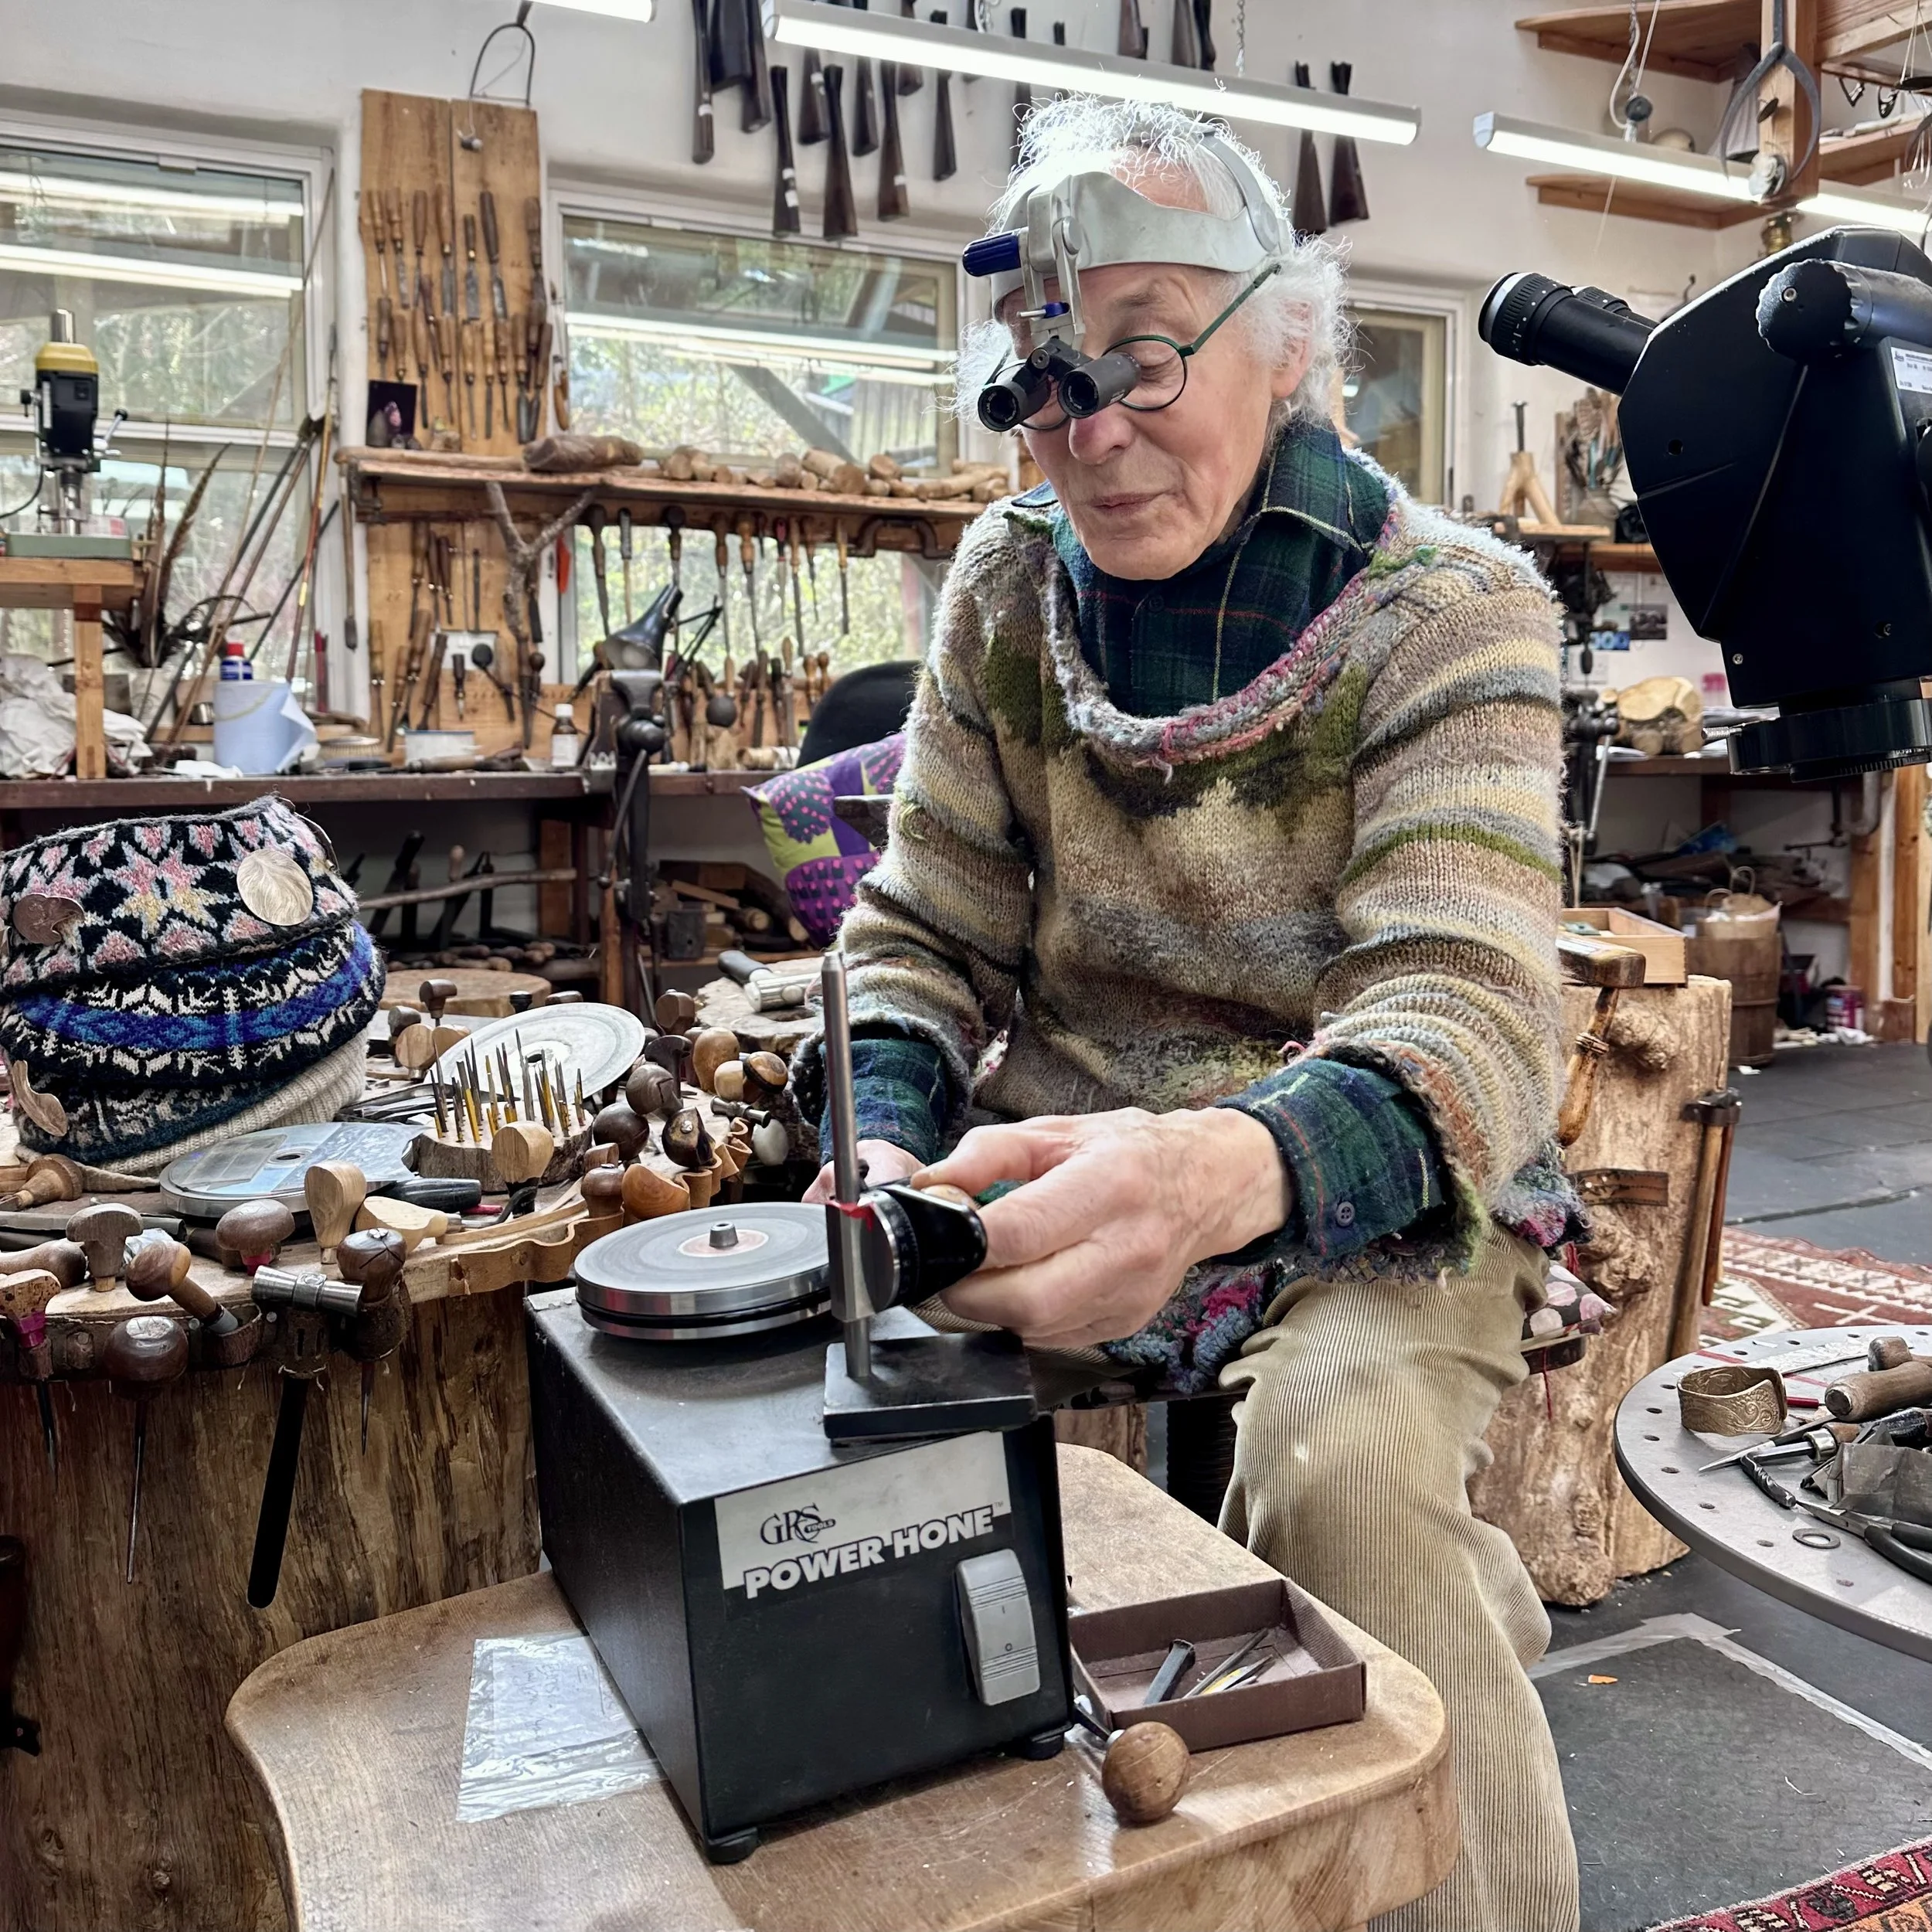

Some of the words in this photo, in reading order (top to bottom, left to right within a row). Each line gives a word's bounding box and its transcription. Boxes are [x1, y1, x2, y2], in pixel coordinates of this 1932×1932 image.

[760, 1502, 821, 1545] GRS
[808, 1519, 835, 1532] TOOLS
[743, 1536, 885, 1599] POWER
[891, 1504, 994, 1559] HONE
